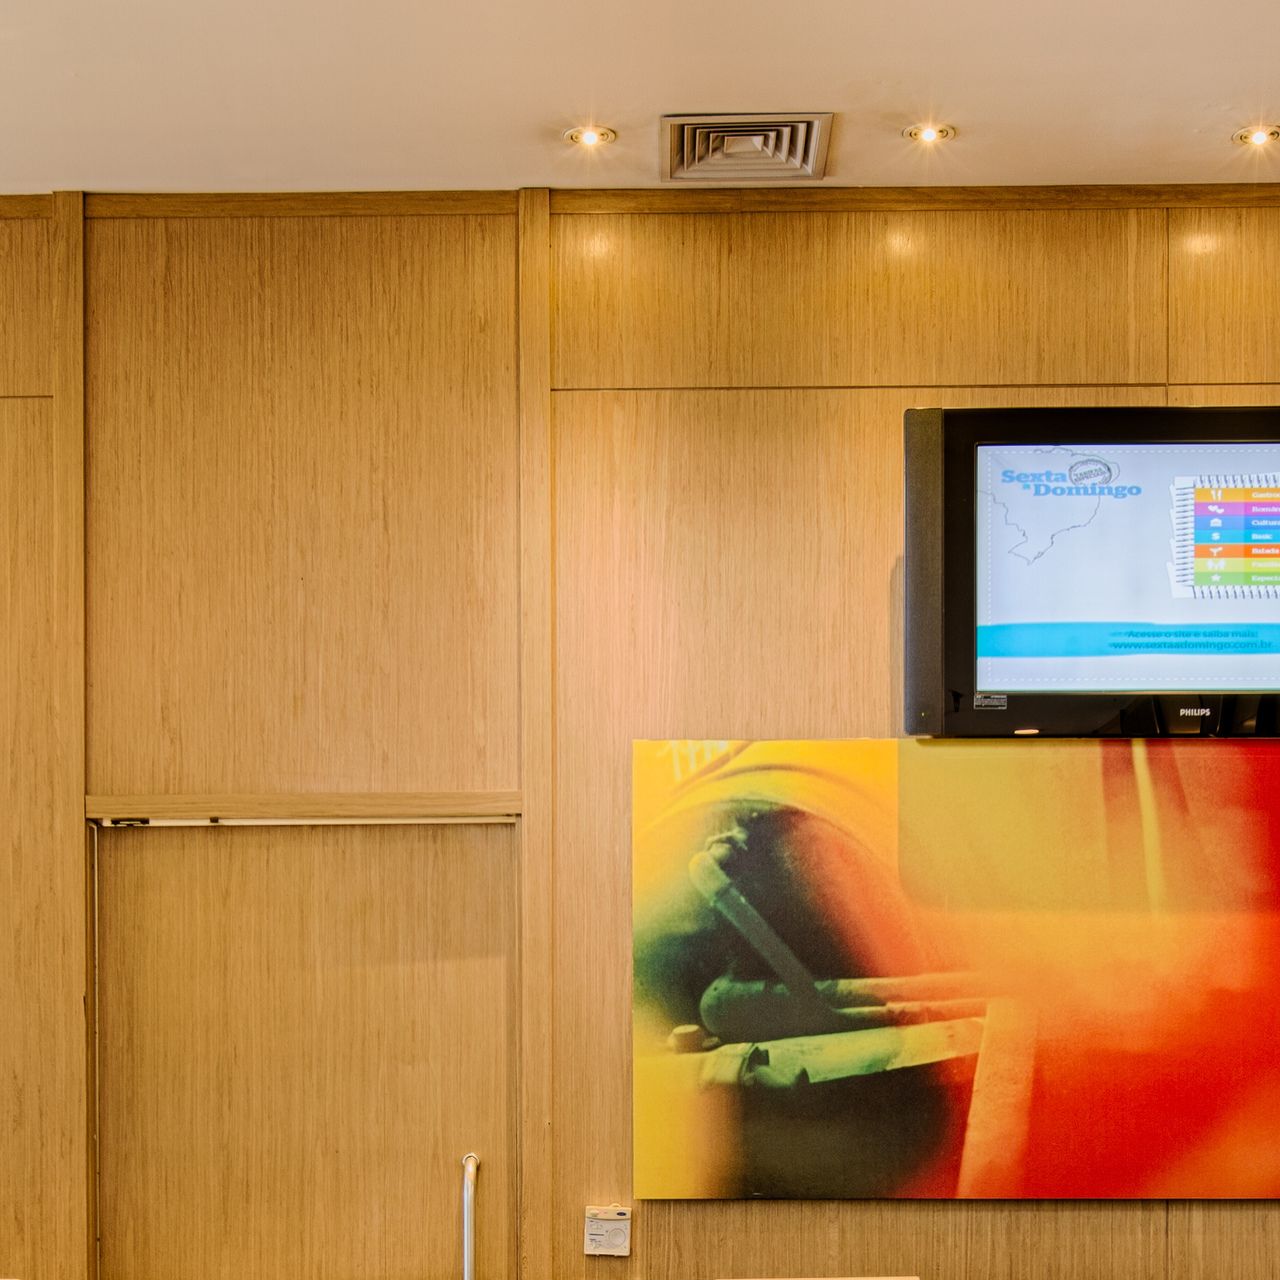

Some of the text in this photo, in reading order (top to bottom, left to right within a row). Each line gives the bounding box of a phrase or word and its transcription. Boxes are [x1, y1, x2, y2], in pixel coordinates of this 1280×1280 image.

[1001, 469, 1067, 483] Sexta
[1033, 483, 1142, 499] Domingo
[1127, 630, 1163, 638] Acesse
[1171, 630, 1192, 638] site
[1202, 630, 1229, 638] saiba
[1180, 708, 1210, 716] PHILIPS
